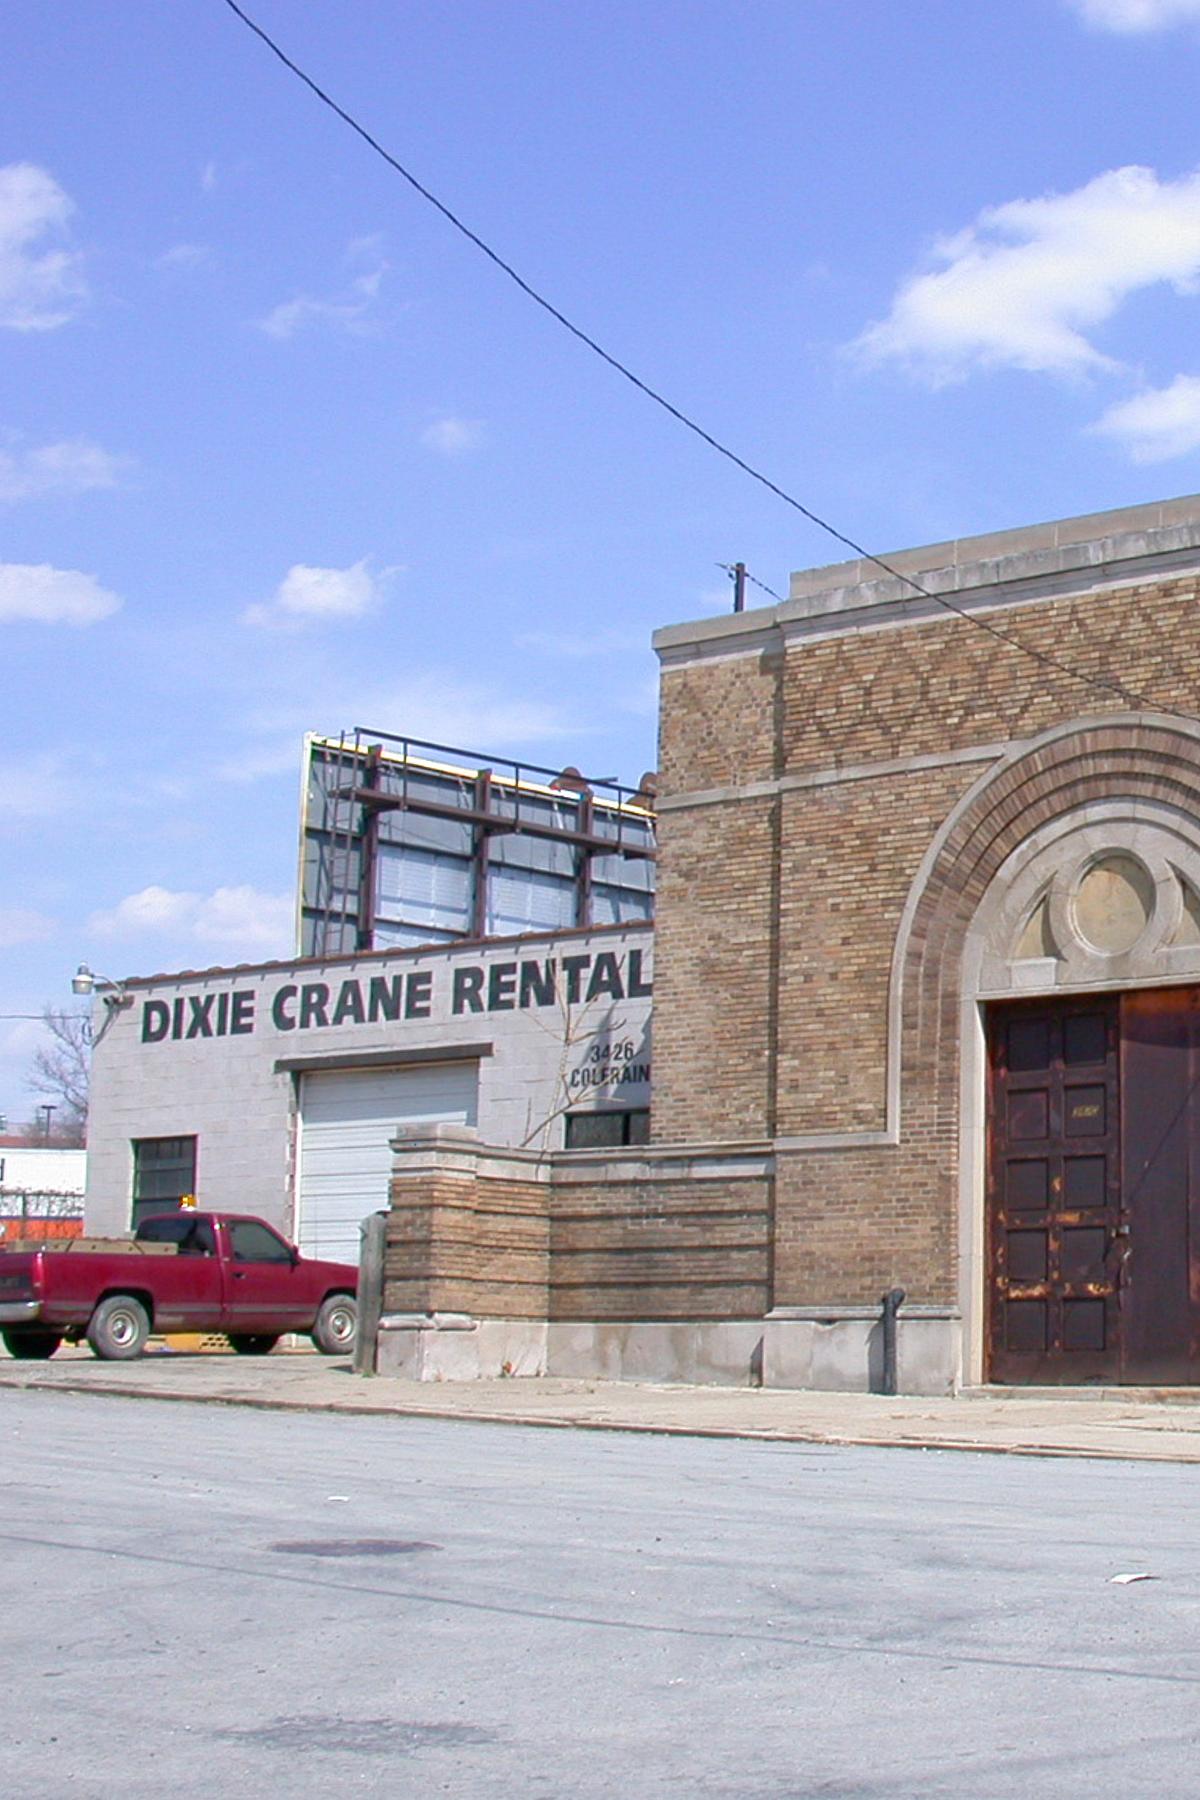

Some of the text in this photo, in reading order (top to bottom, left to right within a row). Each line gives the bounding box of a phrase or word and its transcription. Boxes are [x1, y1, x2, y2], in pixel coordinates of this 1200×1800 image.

[142, 949, 652, 1043] DIXIE CRANE RENTAL
[590, 1042, 634, 1063] 3426
[570, 1064, 650, 1087] COLERAIN
